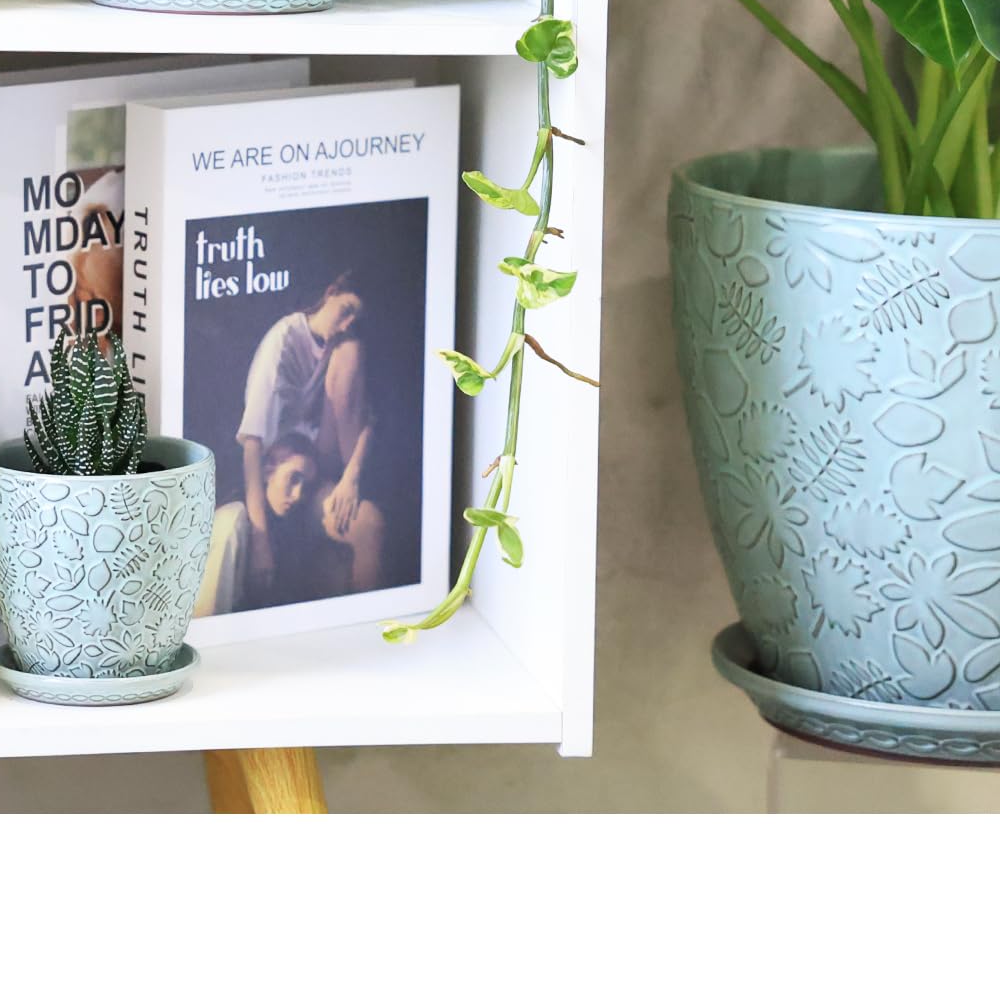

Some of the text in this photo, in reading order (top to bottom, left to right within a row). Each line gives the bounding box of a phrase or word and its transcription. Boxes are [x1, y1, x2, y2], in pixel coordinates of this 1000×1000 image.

[192, 132, 426, 171] WE ARE ON AJOURNEY
[23, 171, 81, 213] MO
[261, 171, 307, 183] FASHION
[23, 209, 124, 256] MDAY
[195, 225, 265, 264] truth
[22, 260, 74, 298] TO
[132, 207, 148, 332] TRUTH
[195, 260, 290, 300] lies low
[25, 298, 110, 343] FRID
